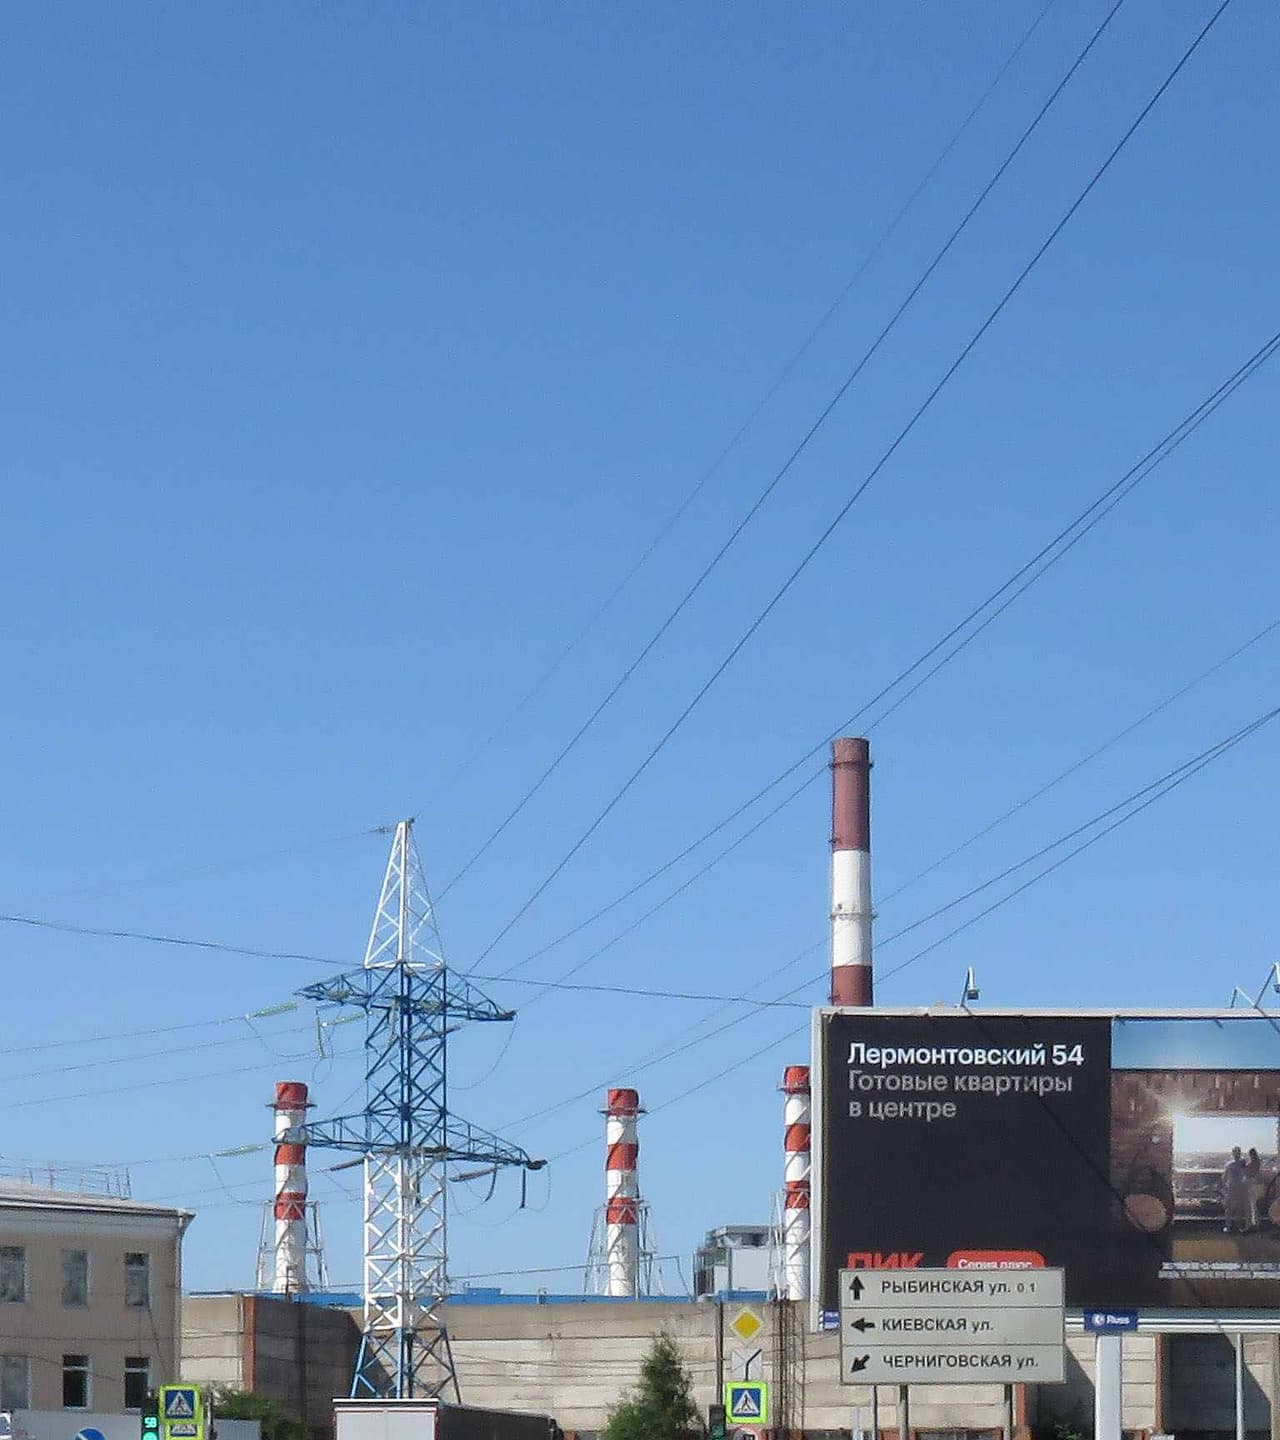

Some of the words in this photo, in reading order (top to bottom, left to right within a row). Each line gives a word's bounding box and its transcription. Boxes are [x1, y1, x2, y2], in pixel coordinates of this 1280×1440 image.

[847, 1043, 1046, 1068] Лермонтовский
[1052, 1044, 1084, 1066] 54
[848, 1070, 948, 1091] Готовые
[954, 1076, 1072, 1096] квартиры
[848, 1103, 862, 1118] в
[869, 1101, 957, 1121] центре
[847, 1253, 924, 1268] ПИК
[881, 1280, 984, 1294] РЫБИНСКАЯ
[989, 1283, 1011, 1296] ул.
[882, 1318, 967, 1332] КИЕВСКАЯ
[972, 1321, 994, 1334] ул.
[883, 1354, 1012, 1369] ЧЕРНИГОВСКАЯ
[1017, 1357, 1039, 1371] ул.
